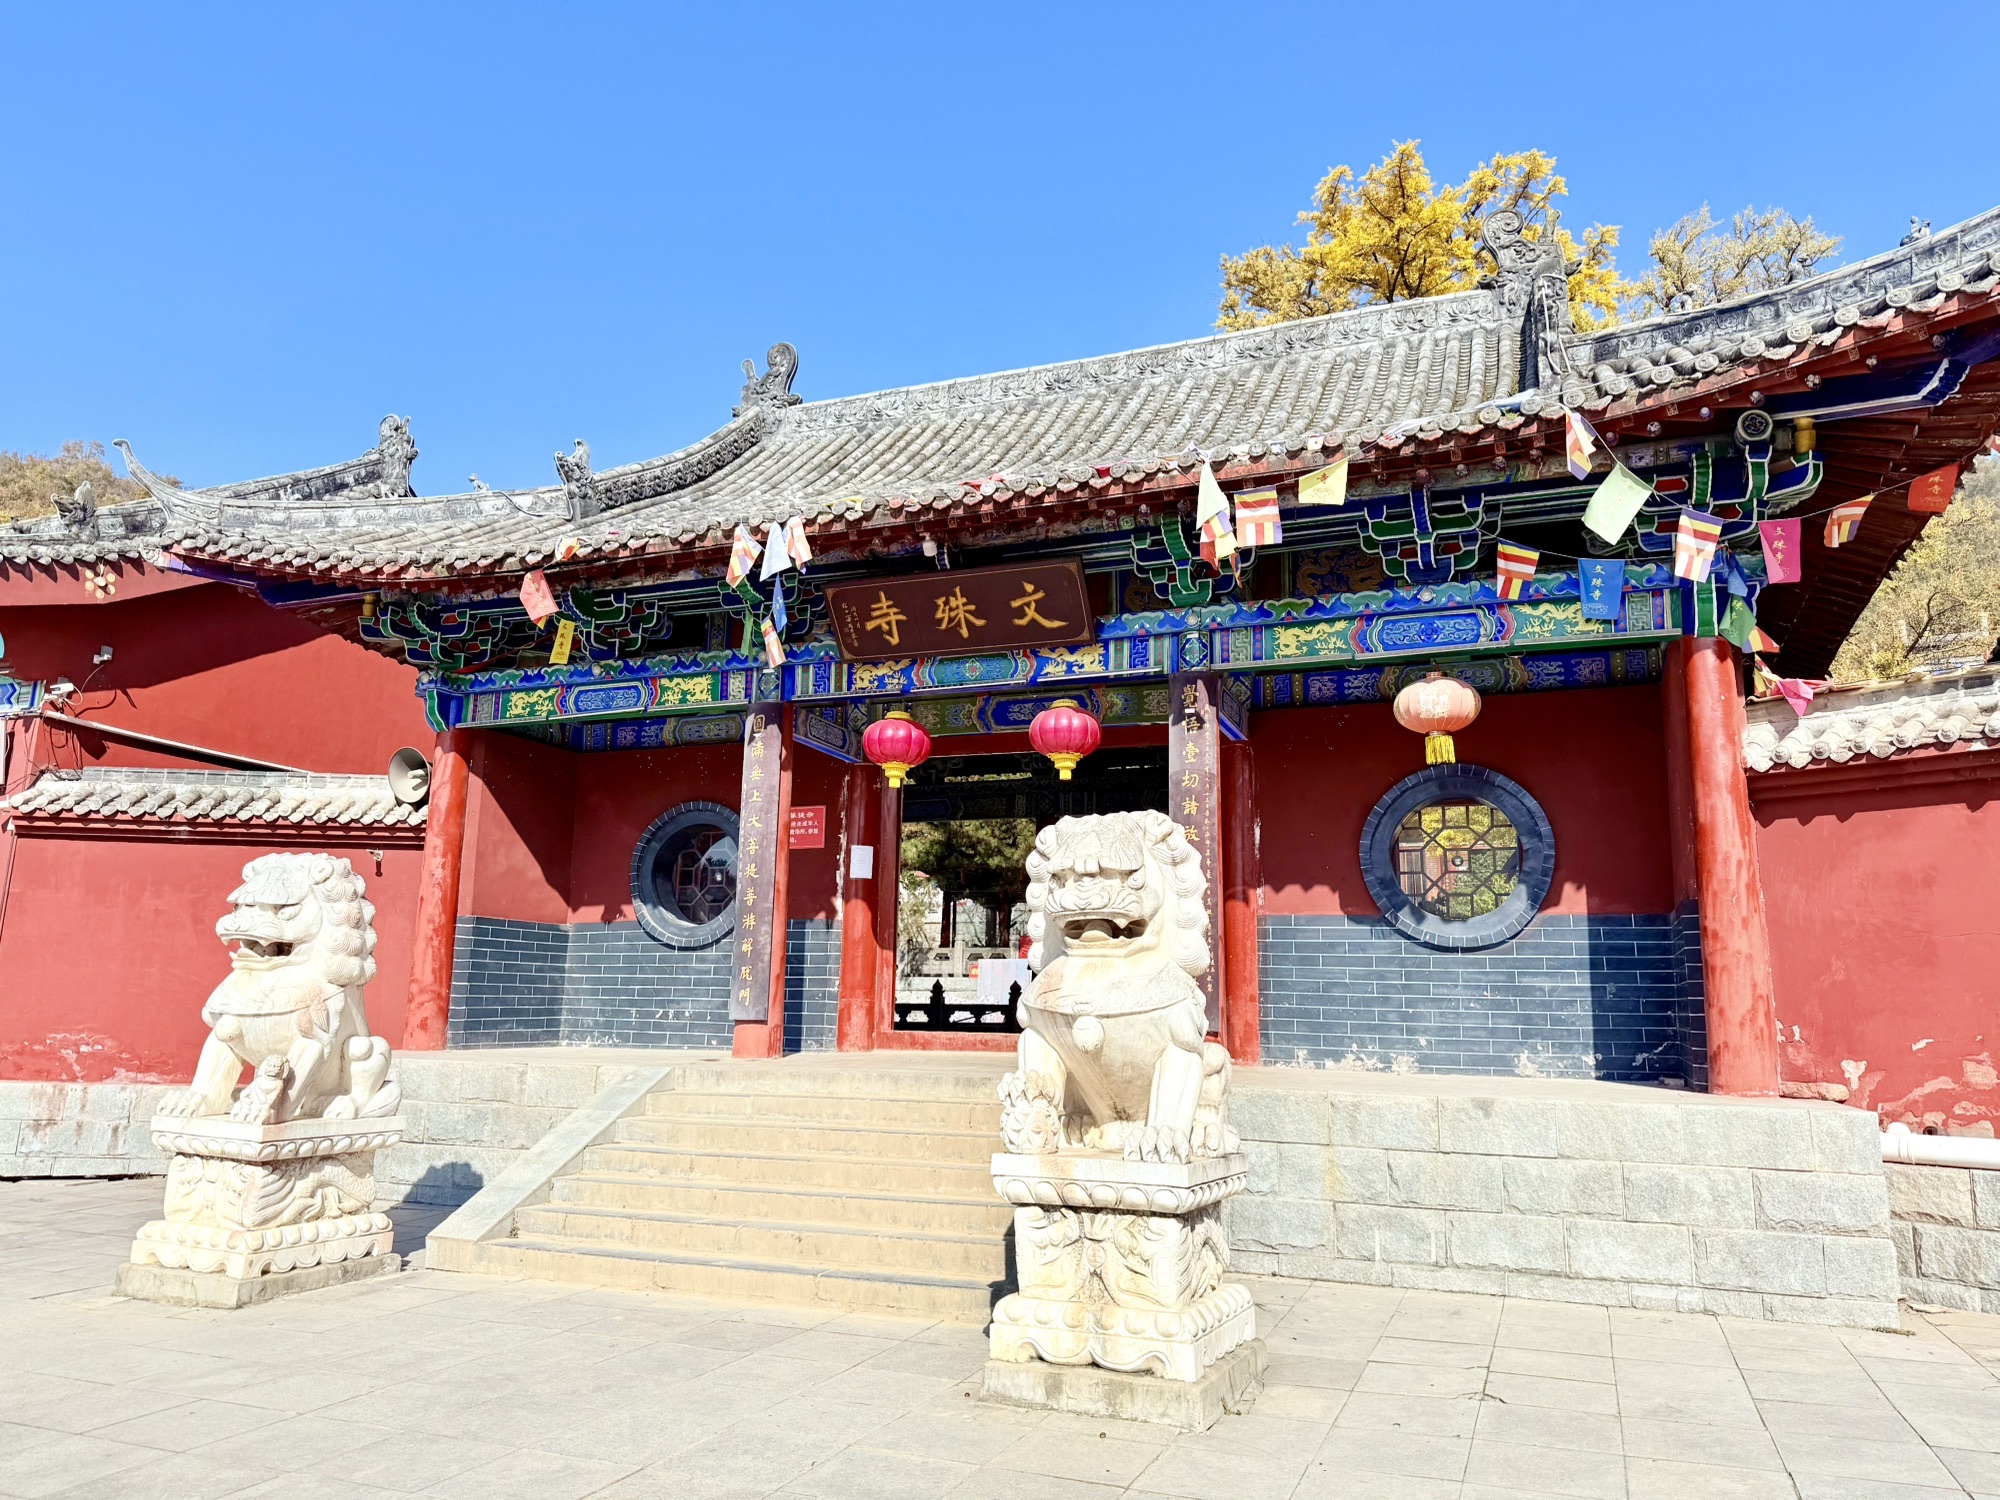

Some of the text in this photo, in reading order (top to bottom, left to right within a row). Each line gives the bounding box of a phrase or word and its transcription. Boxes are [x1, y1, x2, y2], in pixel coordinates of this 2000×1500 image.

[1928, 471, 1943, 494] 殊寺
[1772, 526, 1786, 563] 文殊寺
[1590, 564, 1605, 601] 文殊寺
[865, 581, 1069, 646] 文殊寺
[558, 623, 568, 650] 文殊寺
